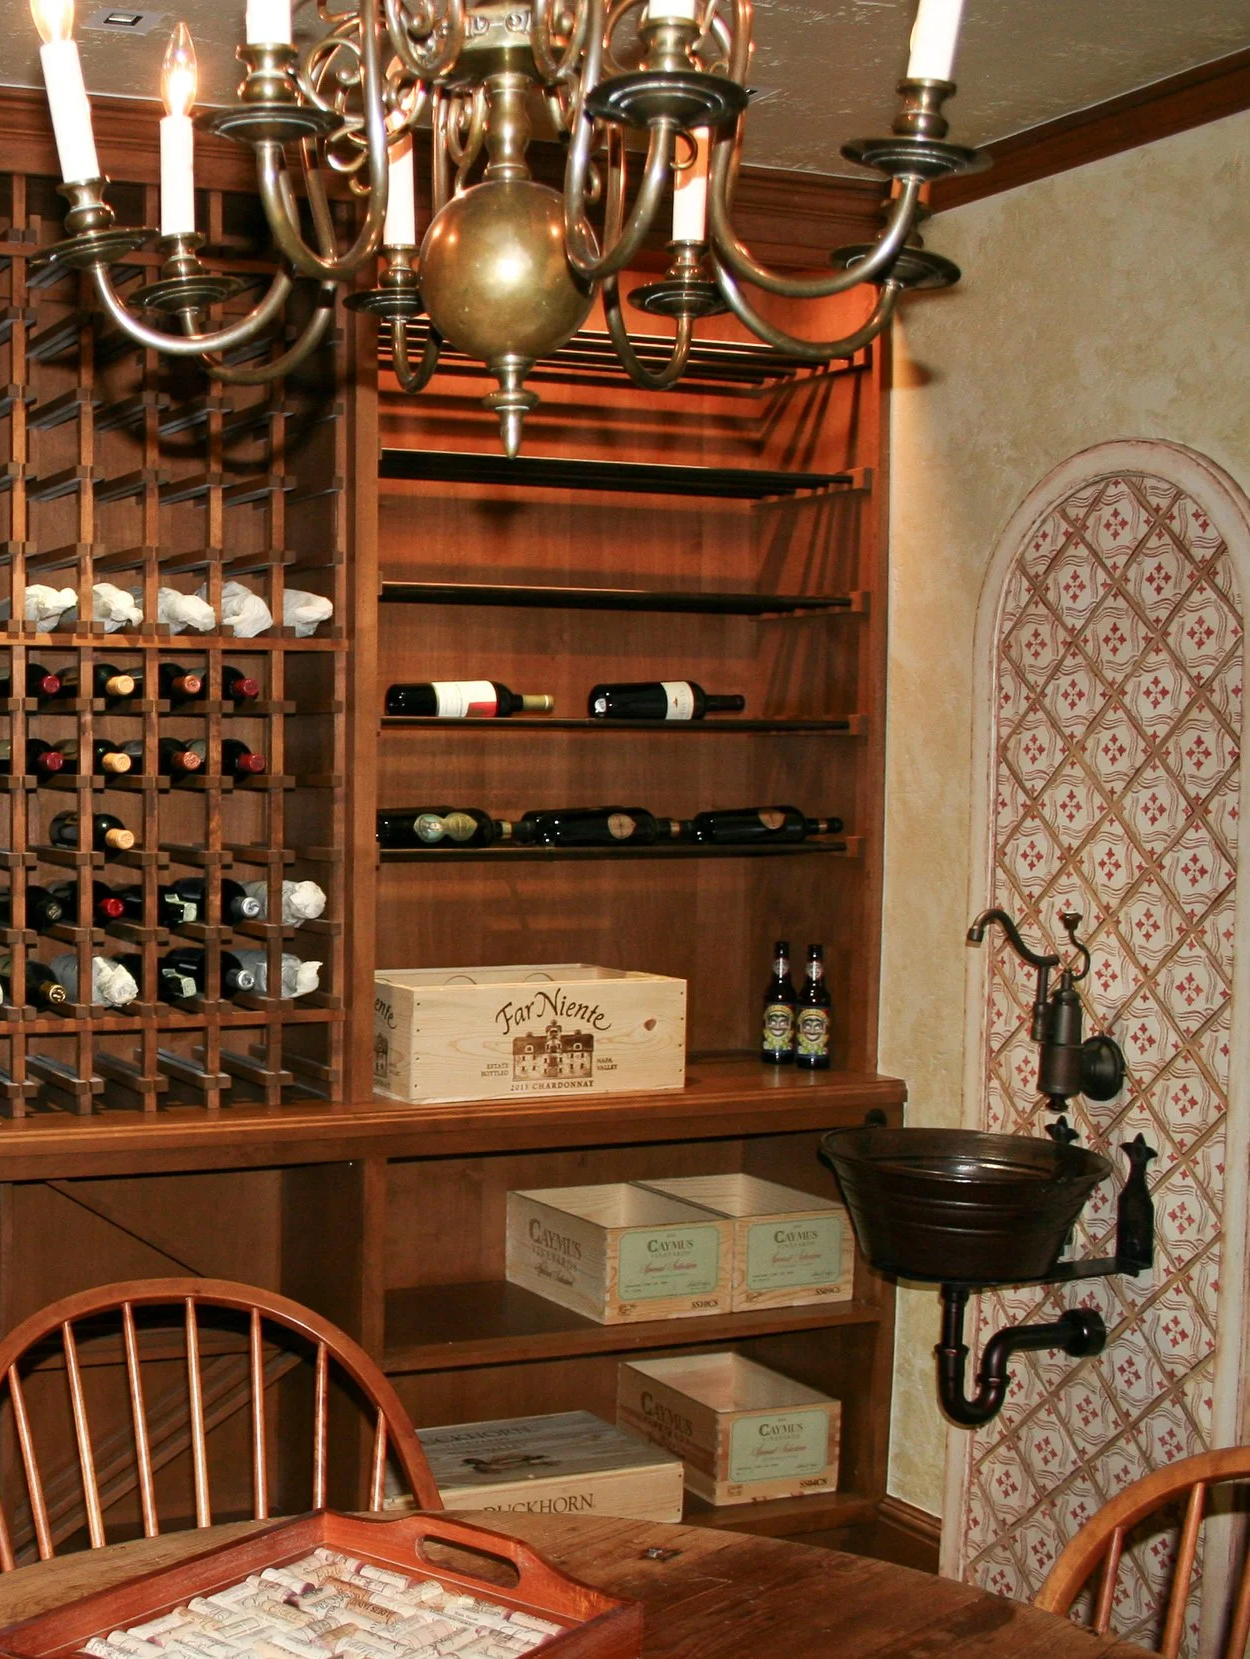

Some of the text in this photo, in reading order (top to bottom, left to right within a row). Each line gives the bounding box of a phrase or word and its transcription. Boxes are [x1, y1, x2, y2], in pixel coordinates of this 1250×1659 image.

[374, 997, 398, 1030] ente
[495, 987, 612, 1035] Far Niente
[595, 1063, 618, 1071] VALLEY
[532, 1080, 594, 1090] CHARDONNAY
[529, 1218, 583, 1260] CAYMUS
[774, 1230, 818, 1243] CAYMUS
[647, 1239, 694, 1253] CAYMUS
[421, 1426, 532, 1444] UCKHORN
[758, 1423, 803, 1437] CAYMUS
